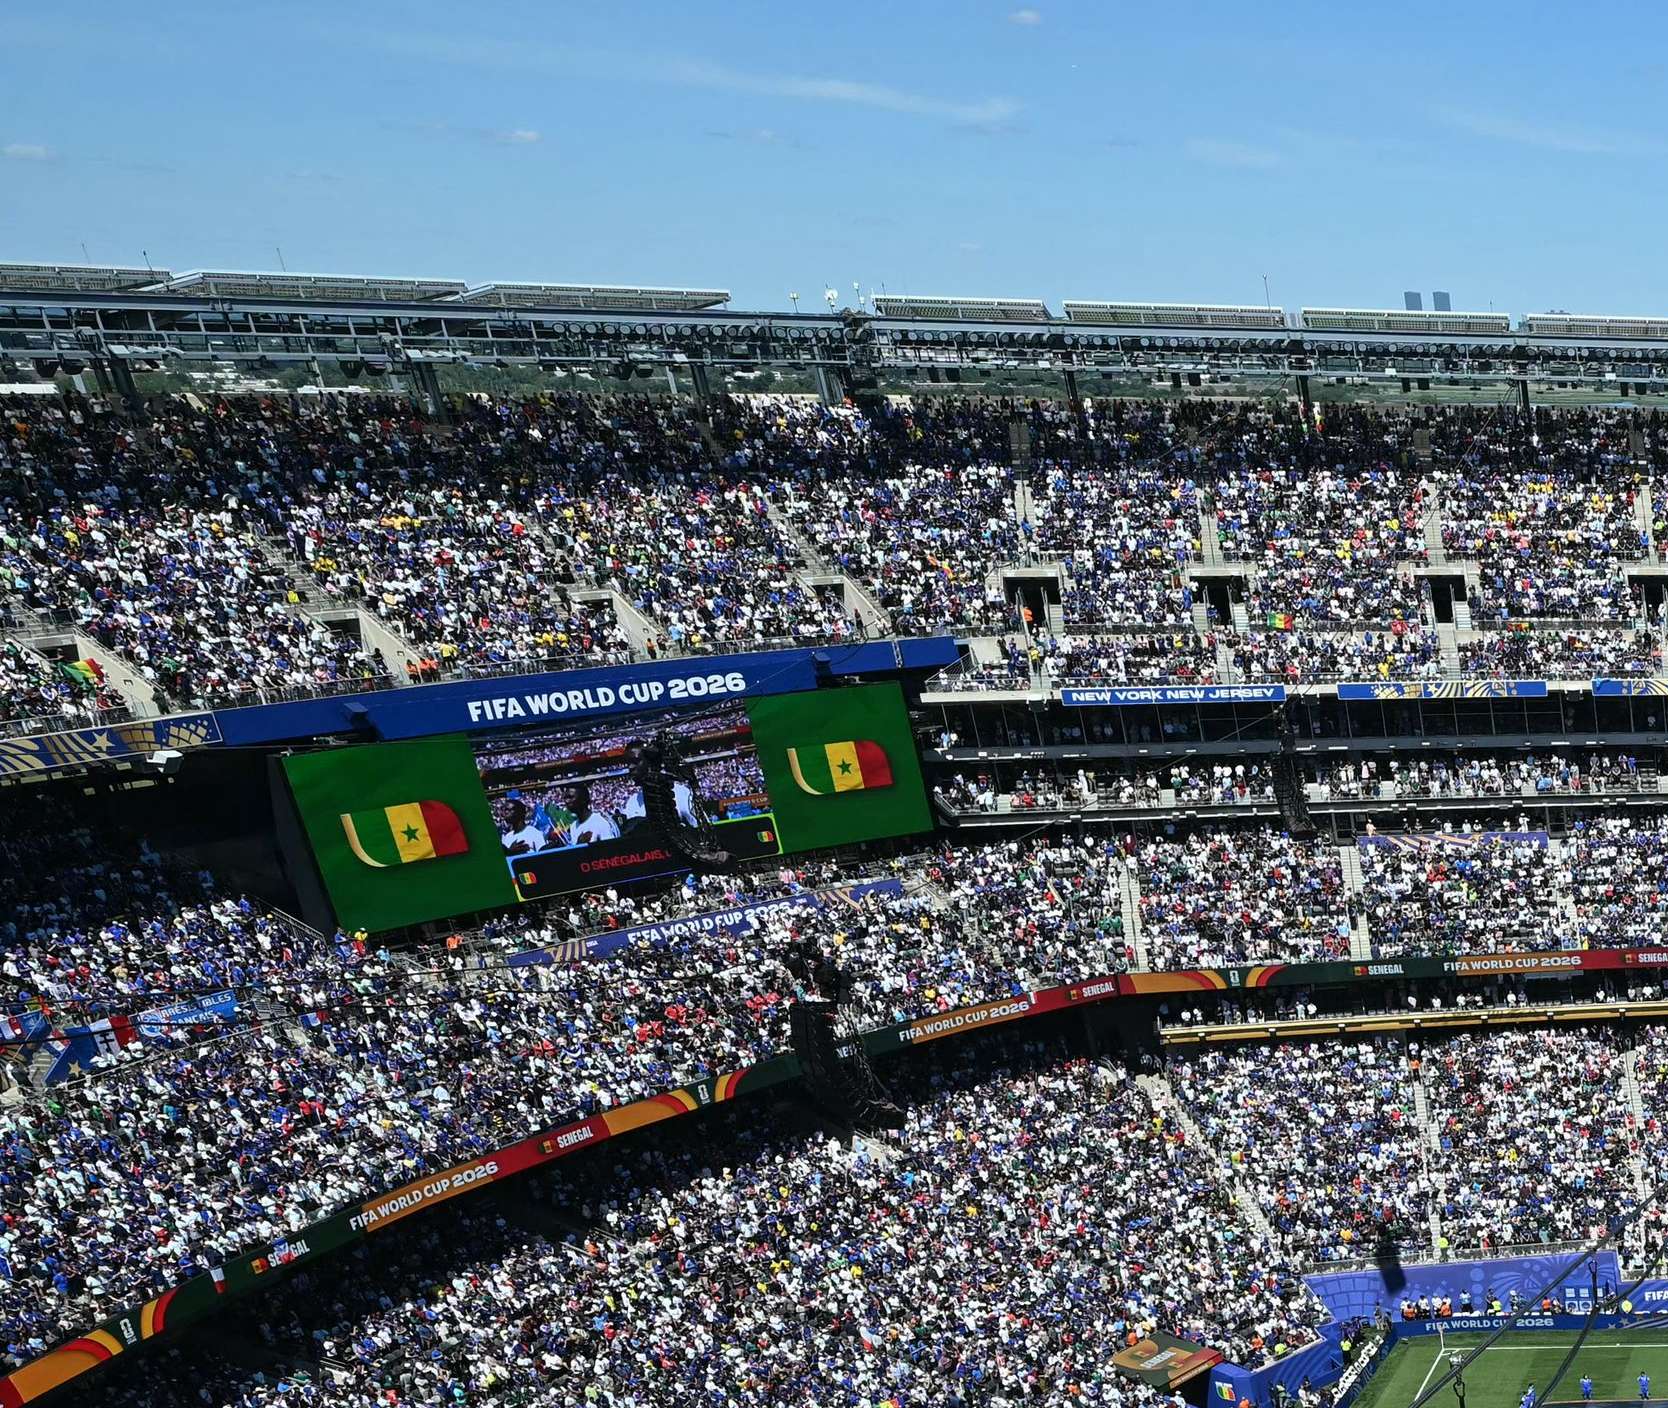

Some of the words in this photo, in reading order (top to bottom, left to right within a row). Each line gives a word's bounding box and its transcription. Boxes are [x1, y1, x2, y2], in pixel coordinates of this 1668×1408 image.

[467, 697, 526, 721] FIFA
[524, 688, 615, 716] WORLD
[619, 681, 665, 704] CUP
[668, 673, 746, 698] 2026
[1072, 690, 1111, 701] NEW
[1116, 690, 1163, 700] YORK
[1166, 689, 1204, 699] NEW
[1209, 688, 1274, 699] JERSEY
[1368, 964, 1404, 975] SENEGAL
[1443, 961, 1469, 971] FIFA
[1470, 959, 1513, 970] WORLD
[1515, 958, 1538, 968] CUP
[1541, 956, 1582, 967] 2026
[1082, 982, 1114, 997] SENEGAL
[899, 1025, 923, 1042] FIFA
[923, 1015, 964, 1035] WORLD
[965, 1010, 988, 1024] CUP
[989, 1002, 1029, 1018] 2026
[557, 1126, 593, 1149] SENEGAL
[350, 1210, 378, 1231] FIFA
[377, 1189, 422, 1218] WORLD
[424, 1179, 449, 1197] CUP
[452, 1161, 498, 1186] 2026
[1426, 1321, 1449, 1331] FIFA
[1451, 1319, 1490, 1329] WORLD
[1516, 1318, 1554, 1327] 2026
